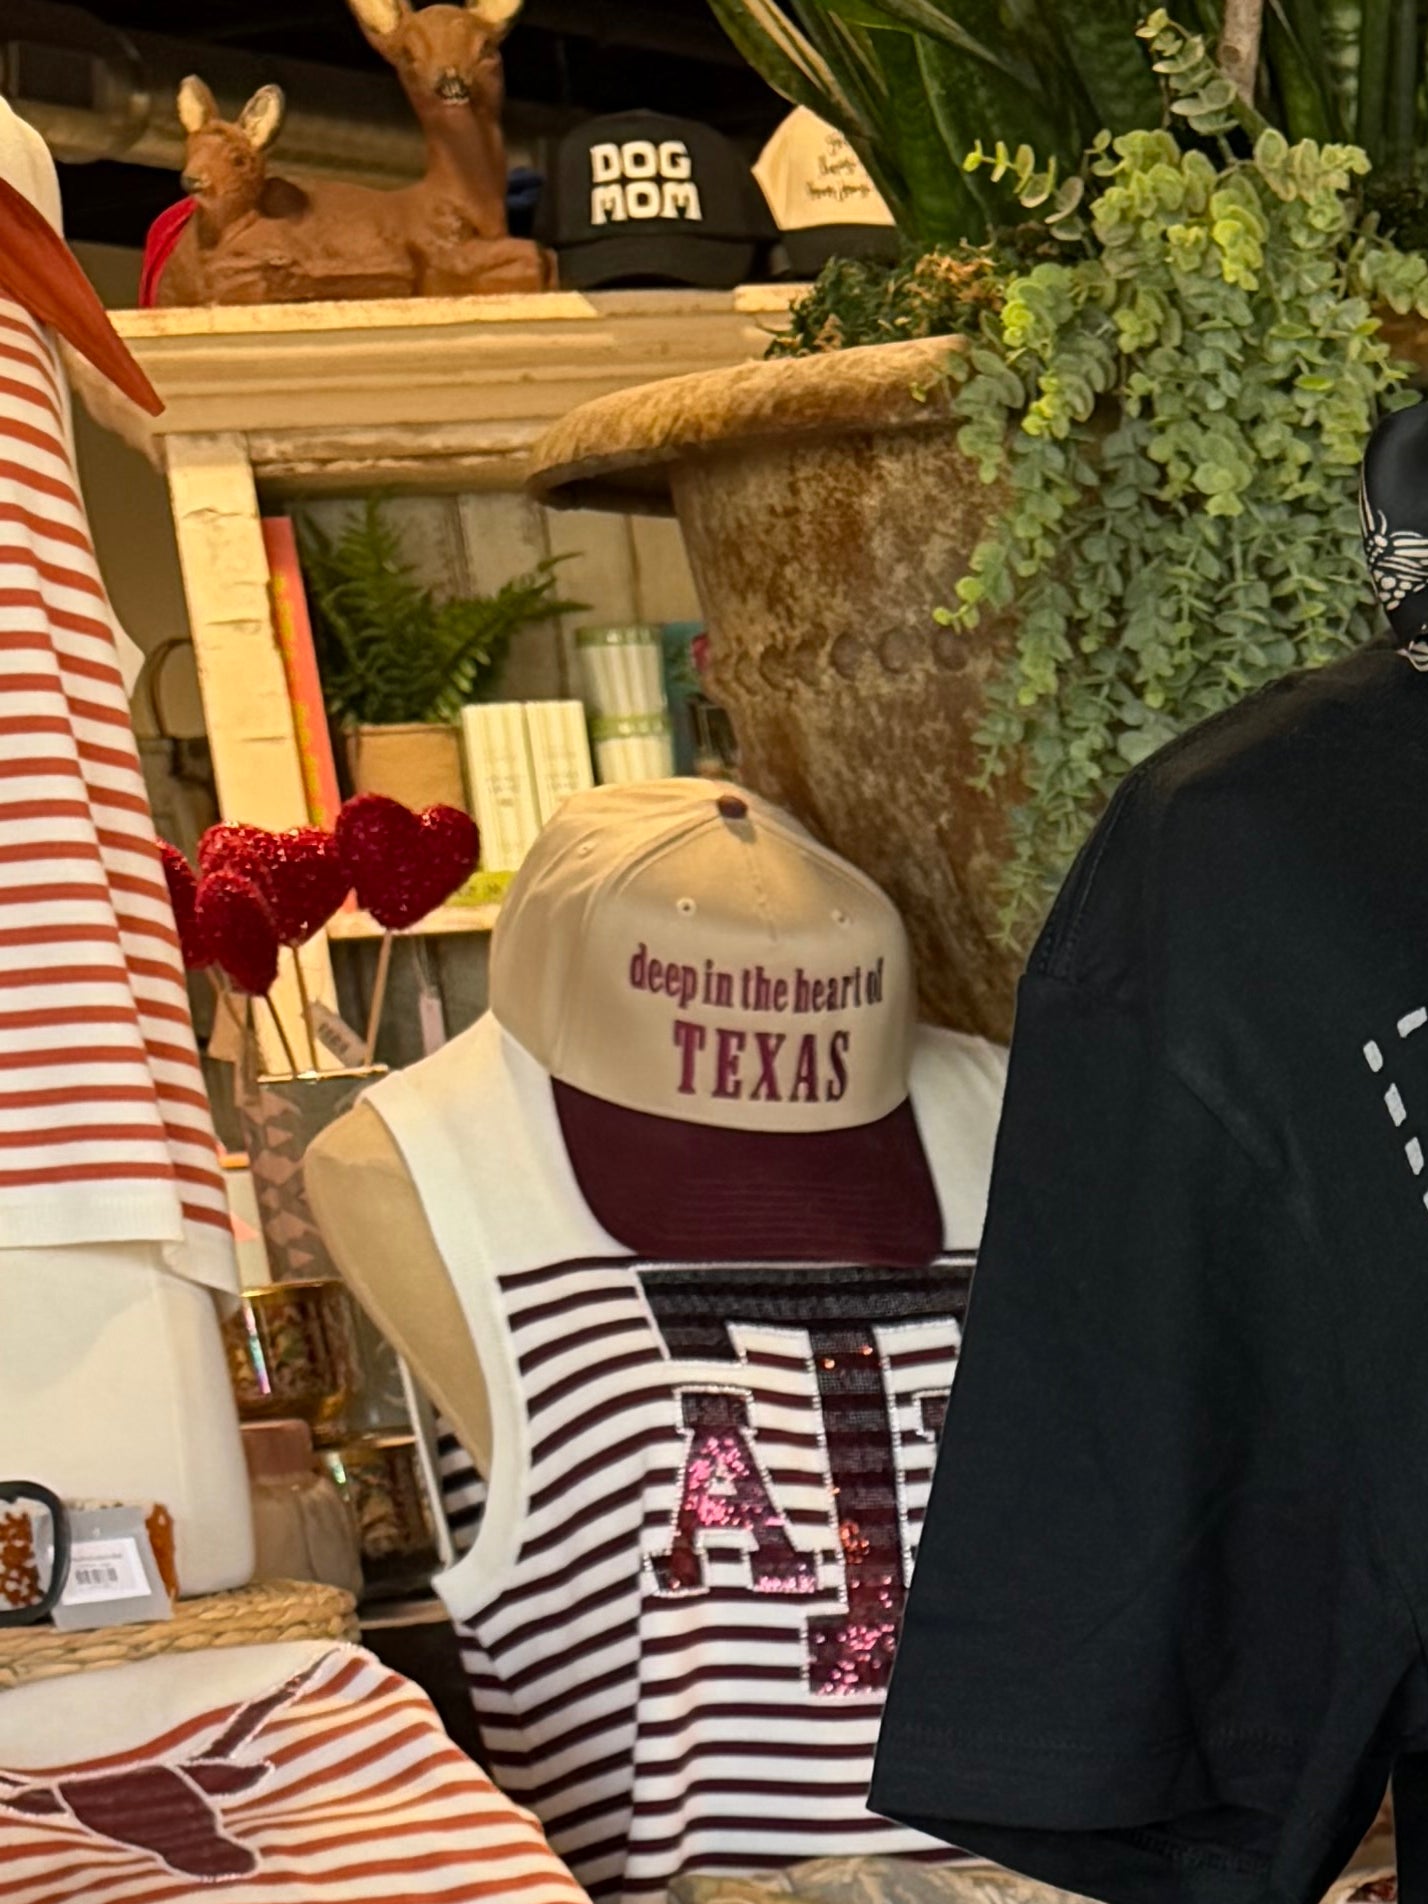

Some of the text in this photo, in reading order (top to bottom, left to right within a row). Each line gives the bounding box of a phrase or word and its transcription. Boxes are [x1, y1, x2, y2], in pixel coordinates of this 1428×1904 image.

[590, 141, 692, 183] DOG
[591, 181, 703, 225] MOM
[630, 942, 884, 1013] deep in the heart of
[673, 1019, 849, 1102] TEXAS
